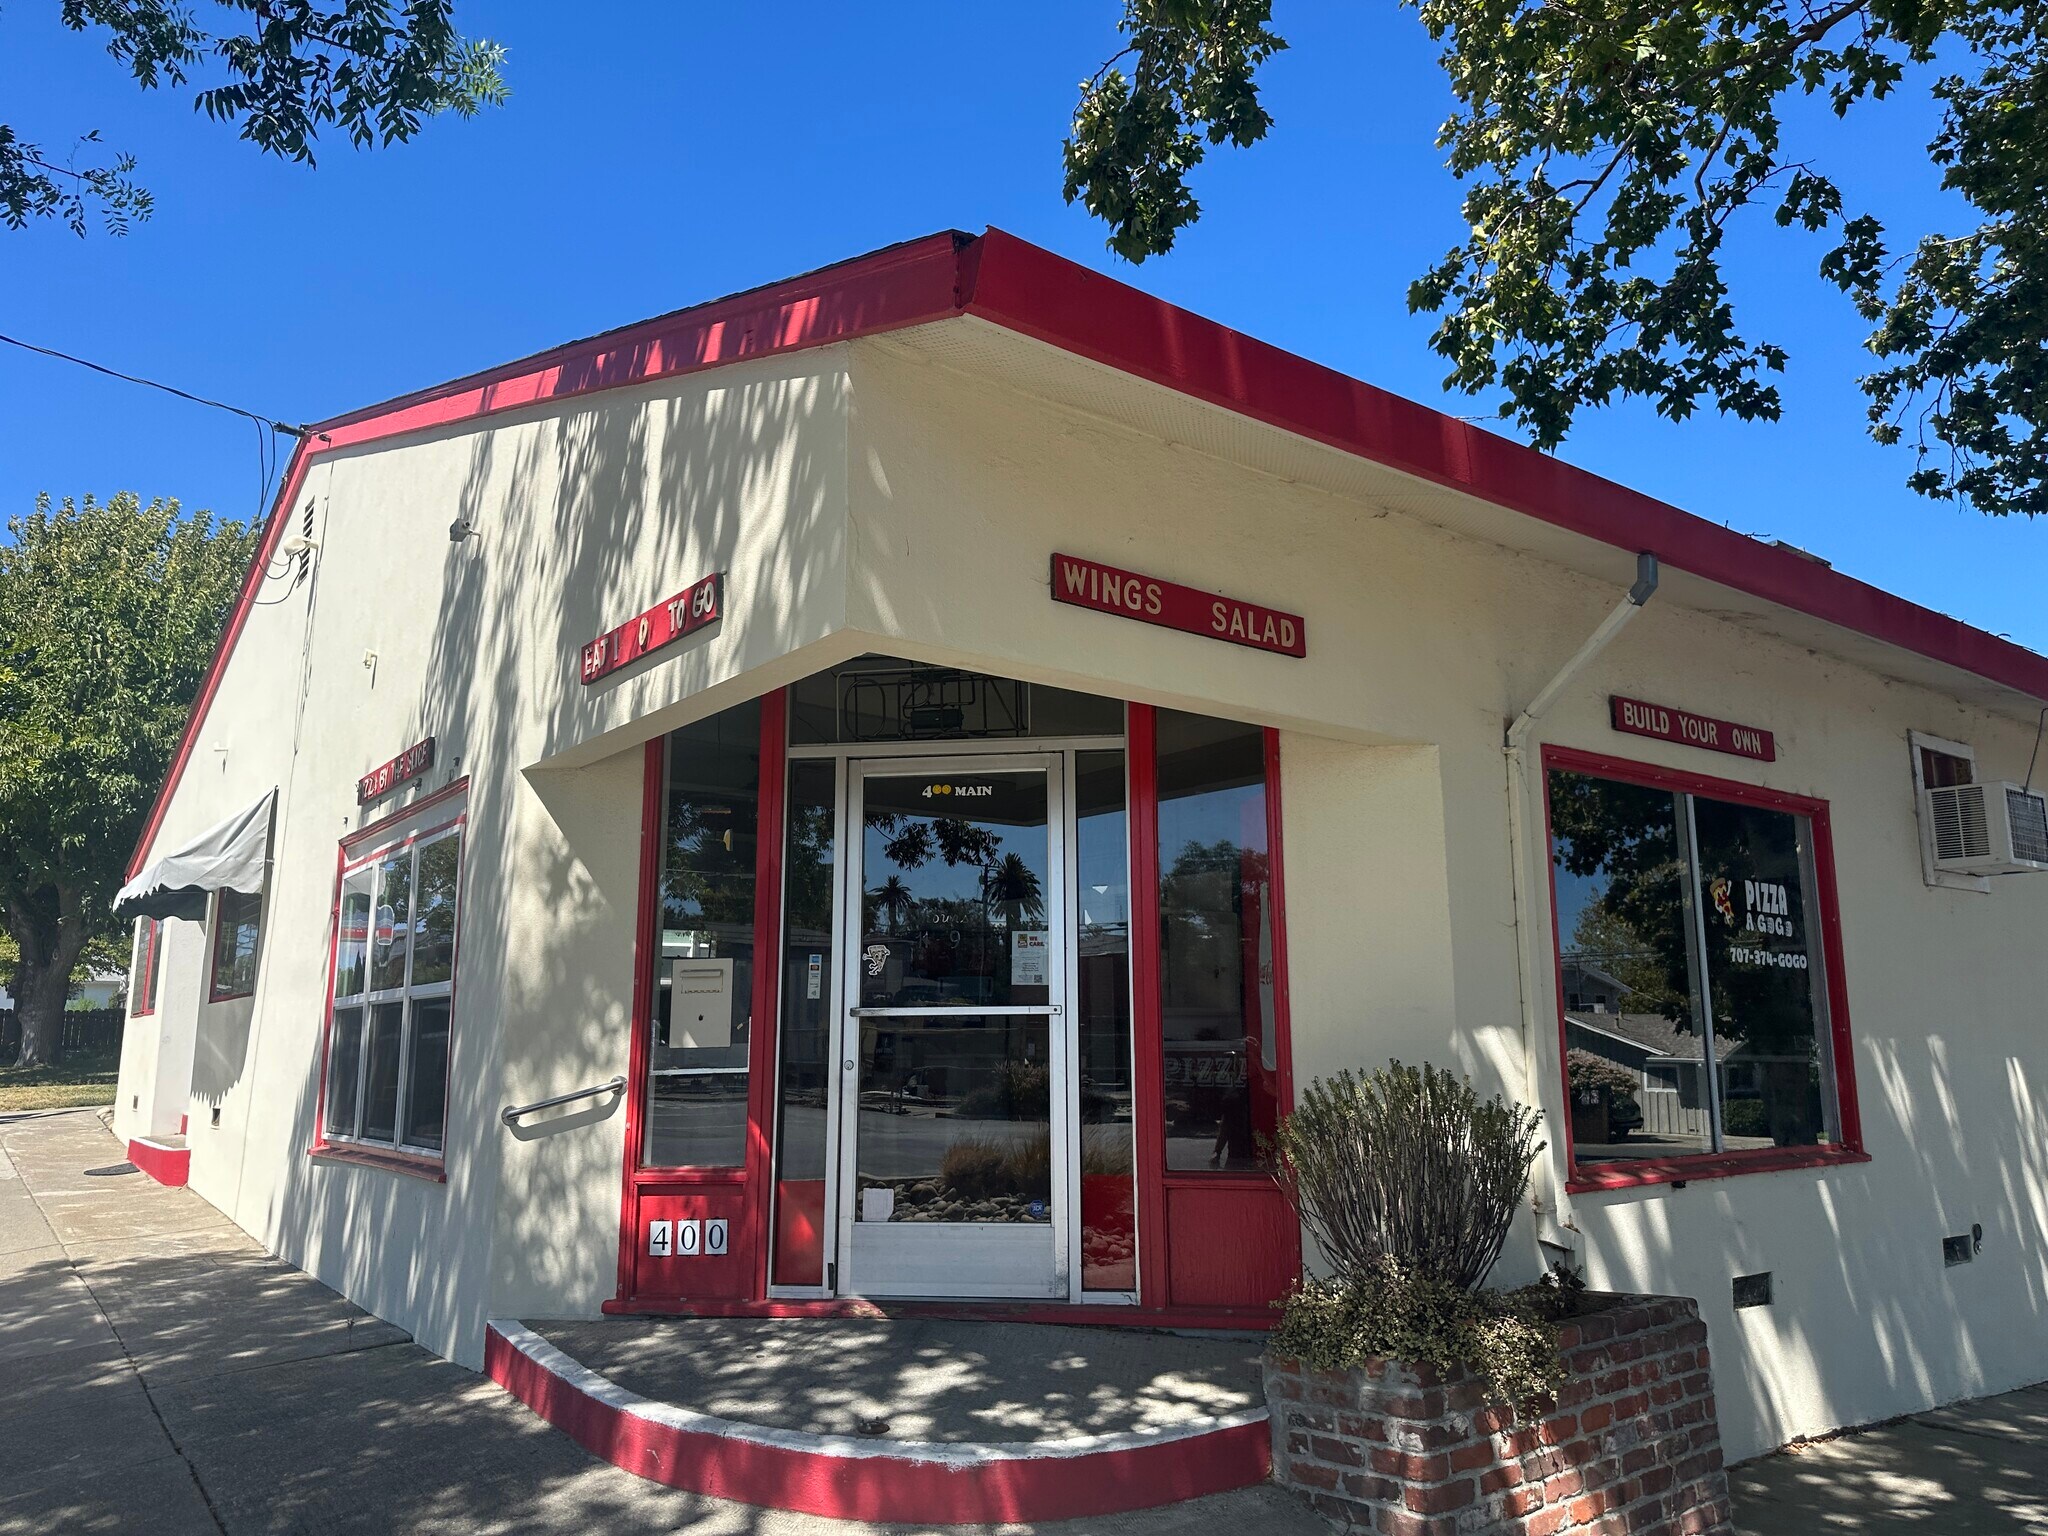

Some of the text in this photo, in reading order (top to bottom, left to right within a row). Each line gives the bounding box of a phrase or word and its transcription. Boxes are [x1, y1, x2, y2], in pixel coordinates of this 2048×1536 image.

[1063, 562, 1296, 648] WINGS SALAD
[584, 638, 609, 676] EAT
[668, 599, 686, 632] TO
[692, 581, 715, 618] GO
[1623, 702, 1762, 754] BUILD YOUR OWN
[379, 767, 389, 790] BY
[391, 757, 404, 781] THE
[406, 743, 427, 773] SLICE
[922, 784, 993, 798] 400 MAIN
[1744, 880, 1788, 915] PIZZA
[1746, 912, 1793, 937] A GOGO
[1730, 947, 1807, 969] 707-374-GOGO
[652, 1224, 724, 1251] 400
